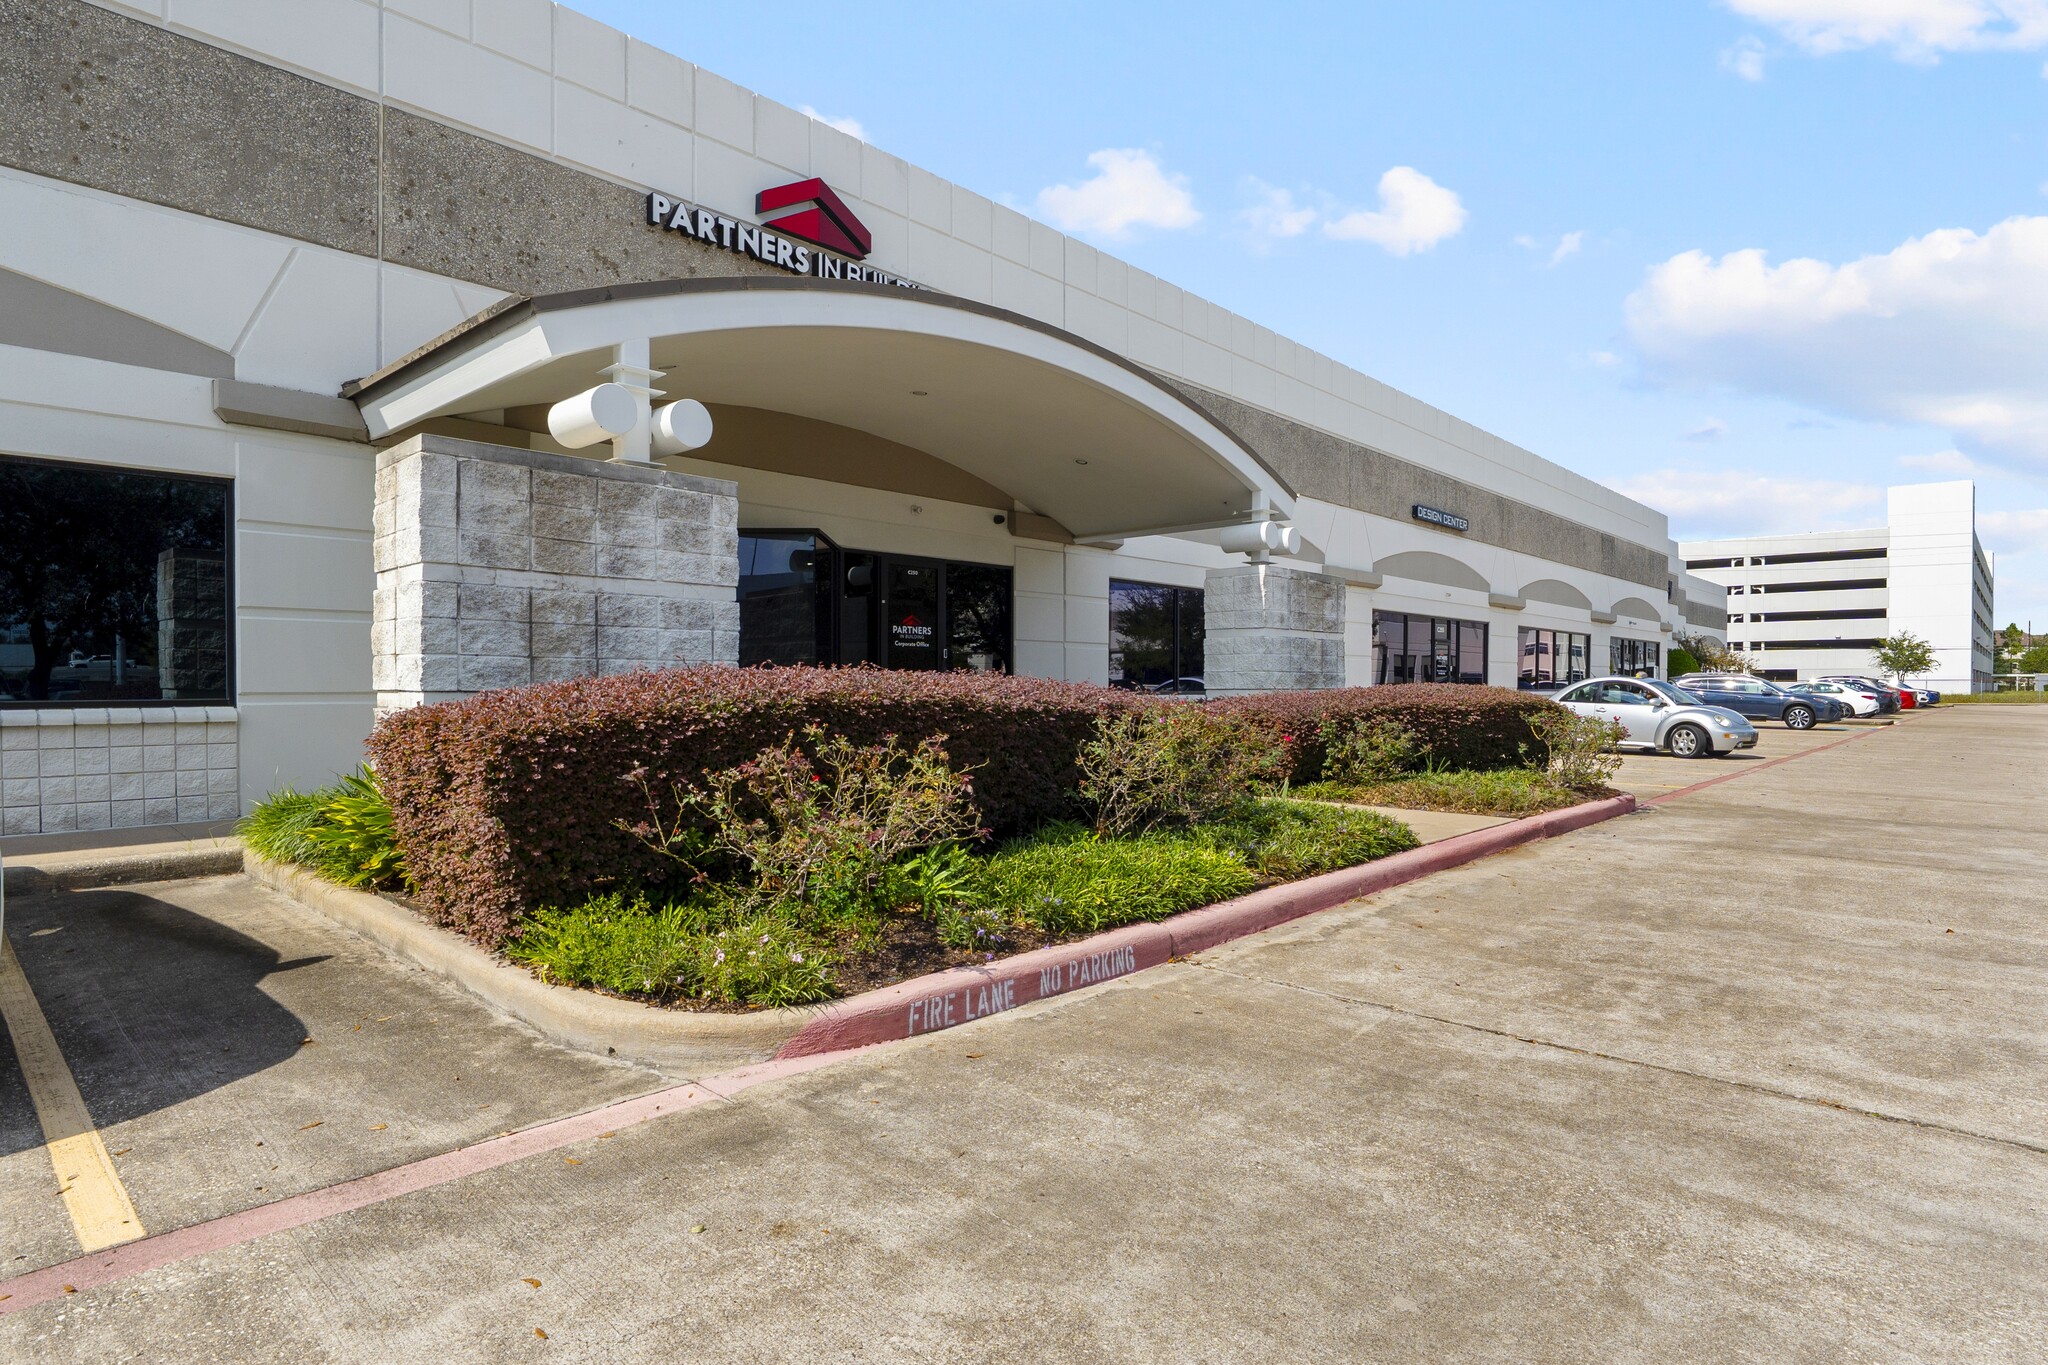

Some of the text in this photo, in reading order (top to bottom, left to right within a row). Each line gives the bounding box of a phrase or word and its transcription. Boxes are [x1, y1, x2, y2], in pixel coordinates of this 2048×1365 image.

[651, 192, 810, 274] PARTNERS
[818, 252, 841, 280] IN
[1417, 506, 1468, 529] DESIGN CENTER
[892, 625, 932, 636] PARTNERS
[894, 640, 916, 648] Corporate
[908, 945, 1136, 1035] FIRE LANE NO PARKING
